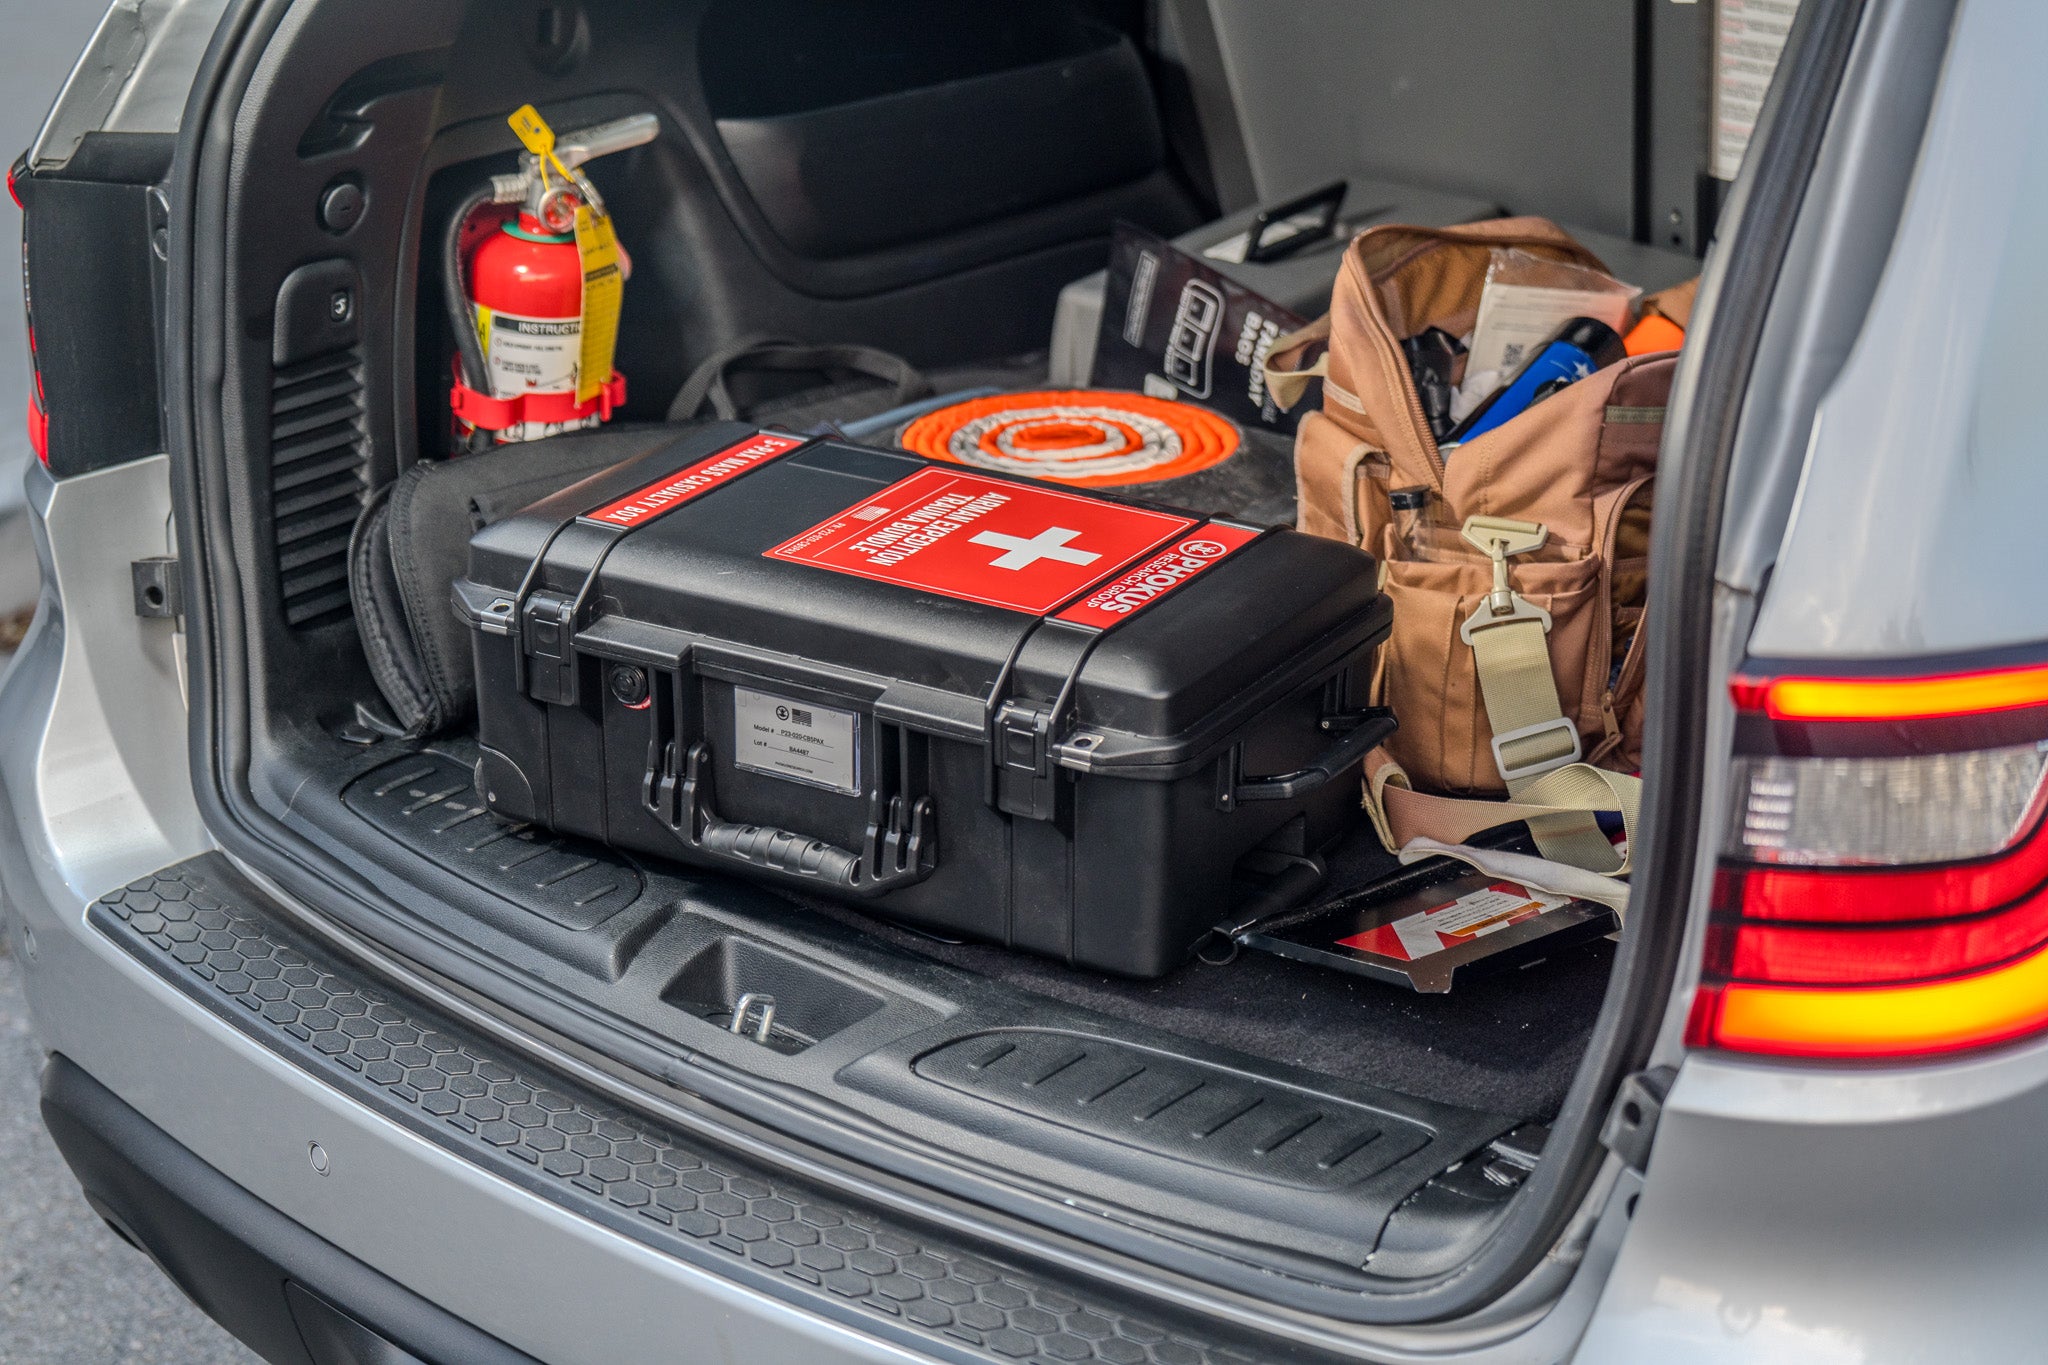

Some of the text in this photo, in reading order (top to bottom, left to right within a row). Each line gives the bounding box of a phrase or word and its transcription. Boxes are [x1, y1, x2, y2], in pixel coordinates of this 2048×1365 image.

[1235, 311, 1263, 366] BAGS
[605, 439, 788, 522] 5-PAX MASS CASUALTY BOX
[848, 492, 976, 554] TRAUMA BUNDLE
[866, 491, 1012, 567] AIRMAN EXPEDITION
[1087, 552, 1180, 608] RESEARCH GROUP
[1101, 557, 1208, 614] PHOKUS
[753, 723, 770, 733] Model
